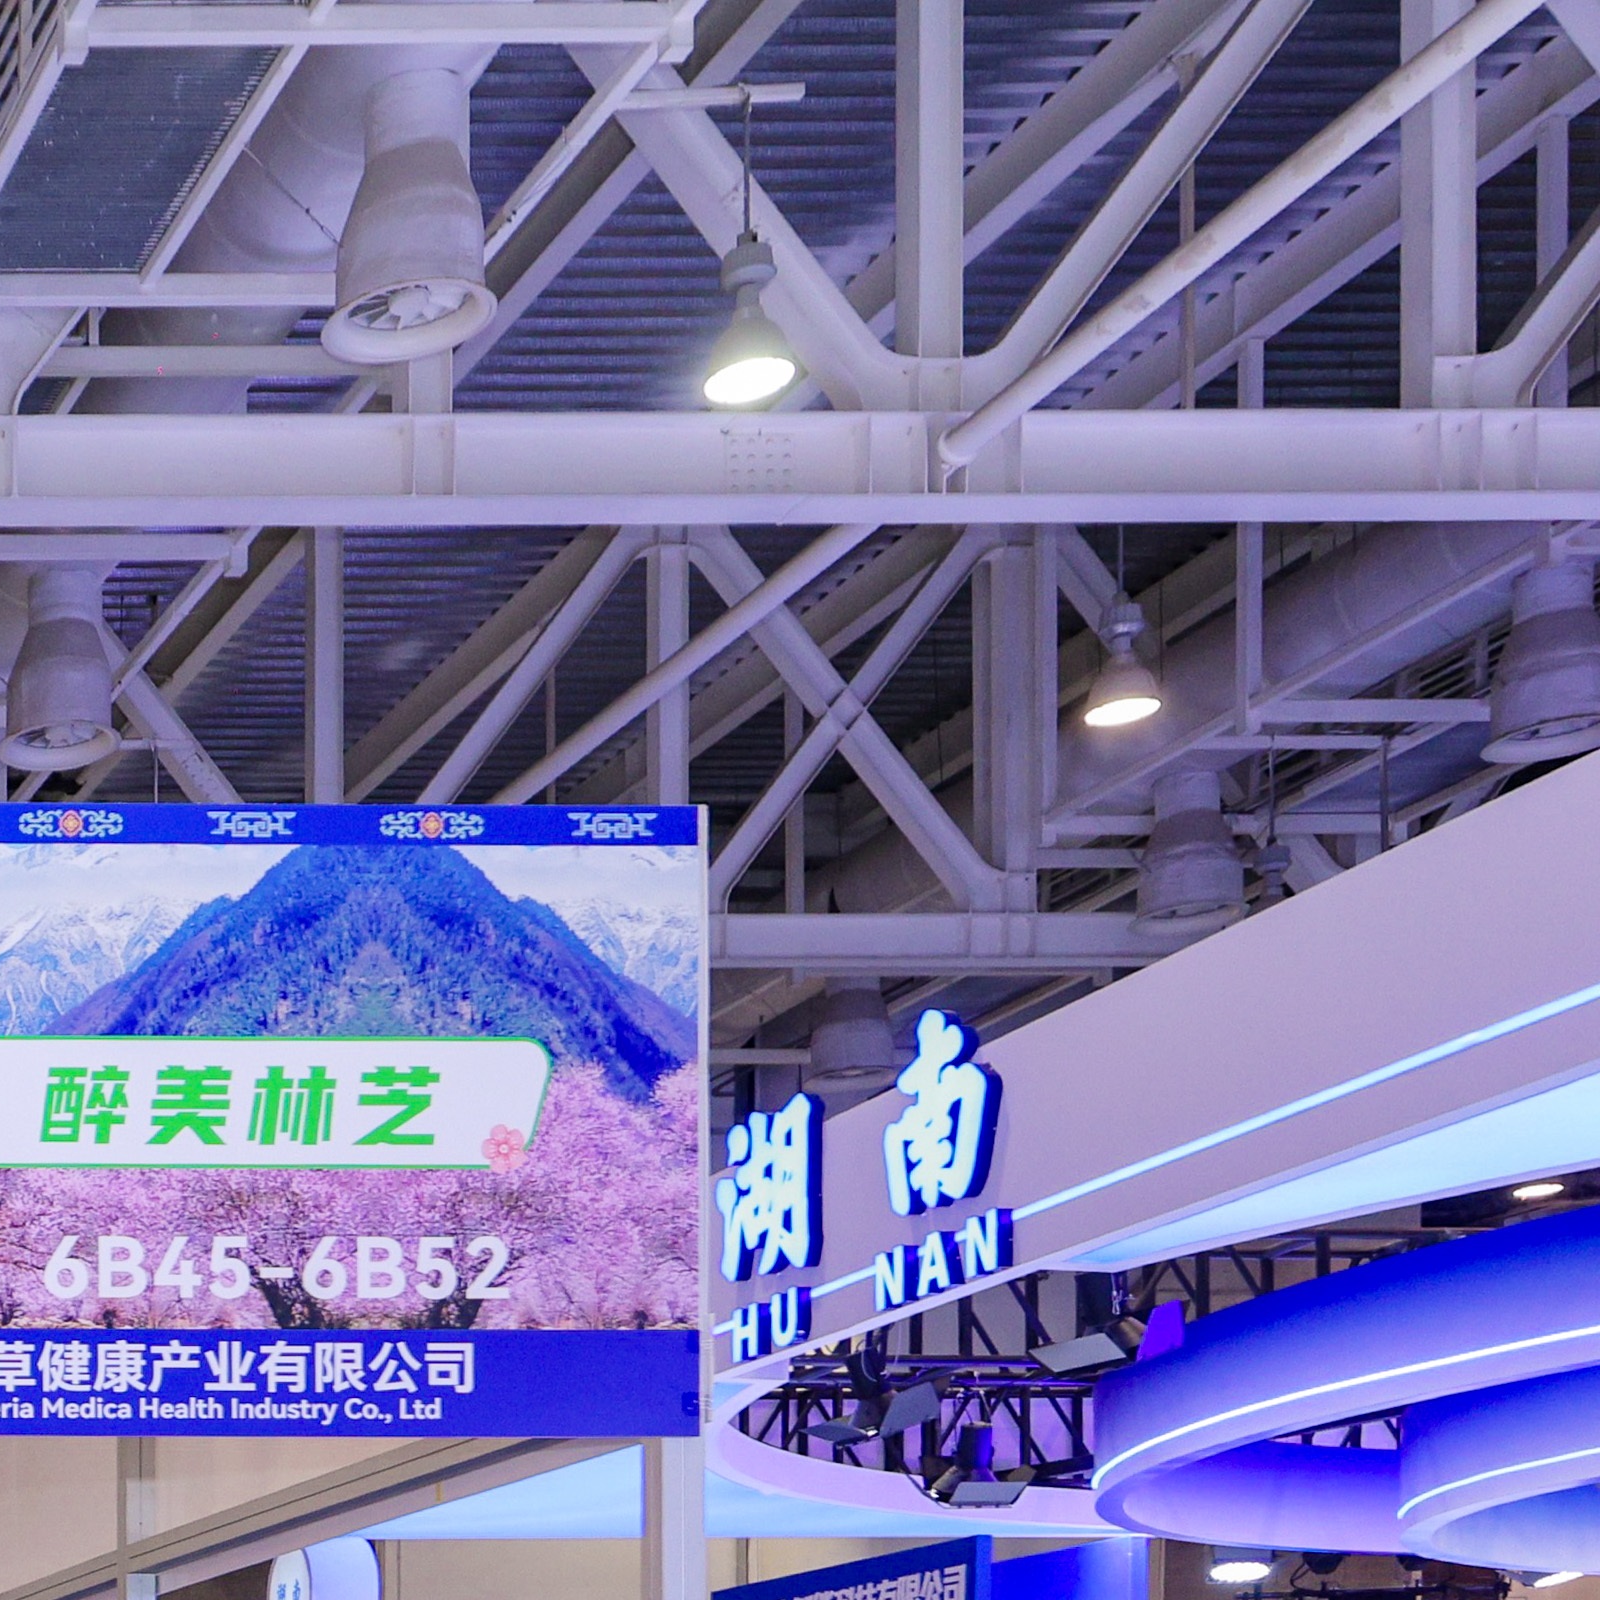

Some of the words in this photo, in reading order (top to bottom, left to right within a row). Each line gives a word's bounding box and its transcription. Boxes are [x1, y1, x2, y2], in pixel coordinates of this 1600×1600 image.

[39, 1063, 442, 1148] 醉美林芝
[717, 1009, 998, 1280] 湖南
[45, 1234, 512, 1302] 6B45-6B52
[732, 1287, 810, 1361] HU
[875, 1208, 1013, 1310] NAN
[41, 1397, 132, 1420] Medica
[139, 1397, 224, 1420] Health
[230, 1397, 338, 1426] Industry
[399, 1397, 442, 1420] Ltd
